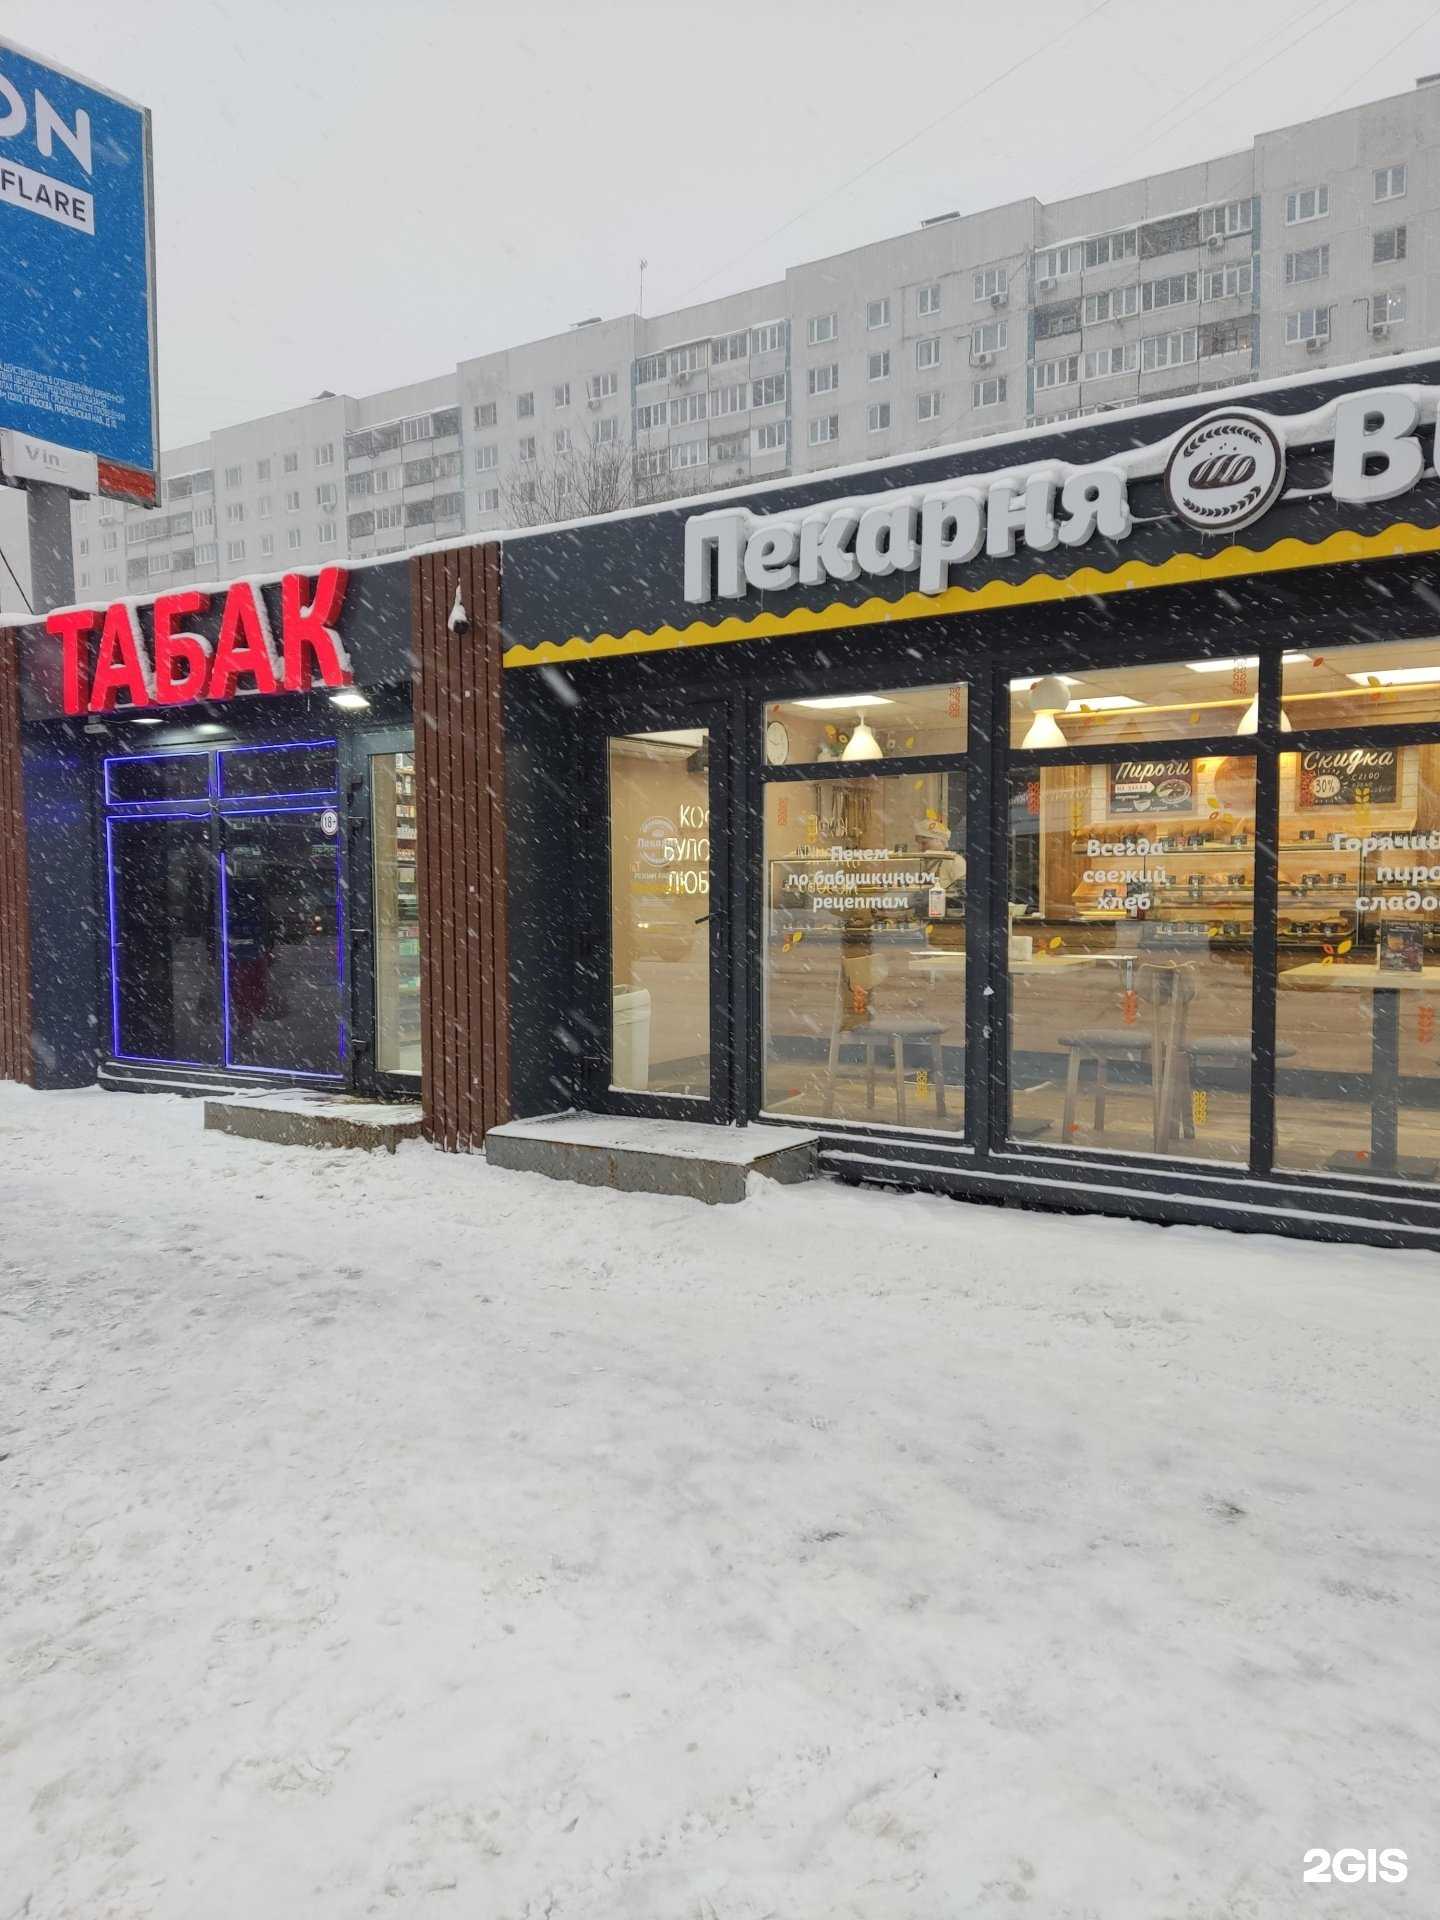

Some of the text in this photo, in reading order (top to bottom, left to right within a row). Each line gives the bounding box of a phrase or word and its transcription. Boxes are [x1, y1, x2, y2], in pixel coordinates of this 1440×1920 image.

[1, 168, 86, 222] FLARE
[684, 388, 1440, 602] Пекарня В
[46, 566, 350, 715] ТАБАК
[1116, 761, 1191, 782] Пироги
[1304, 750, 1394, 774] Скидка
[1314, 779, 1335, 793] 30%
[831, 846, 889, 861] Печем
[1087, 838, 1164, 857] Всегда
[789, 873, 809, 886] по
[815, 870, 935, 890] бабушкиным
[1083, 865, 1166, 883] свежий
[813, 896, 909, 912] рецептам
[1097, 893, 1151, 911] хлеб
[1356, 891, 1440, 912] сладо
